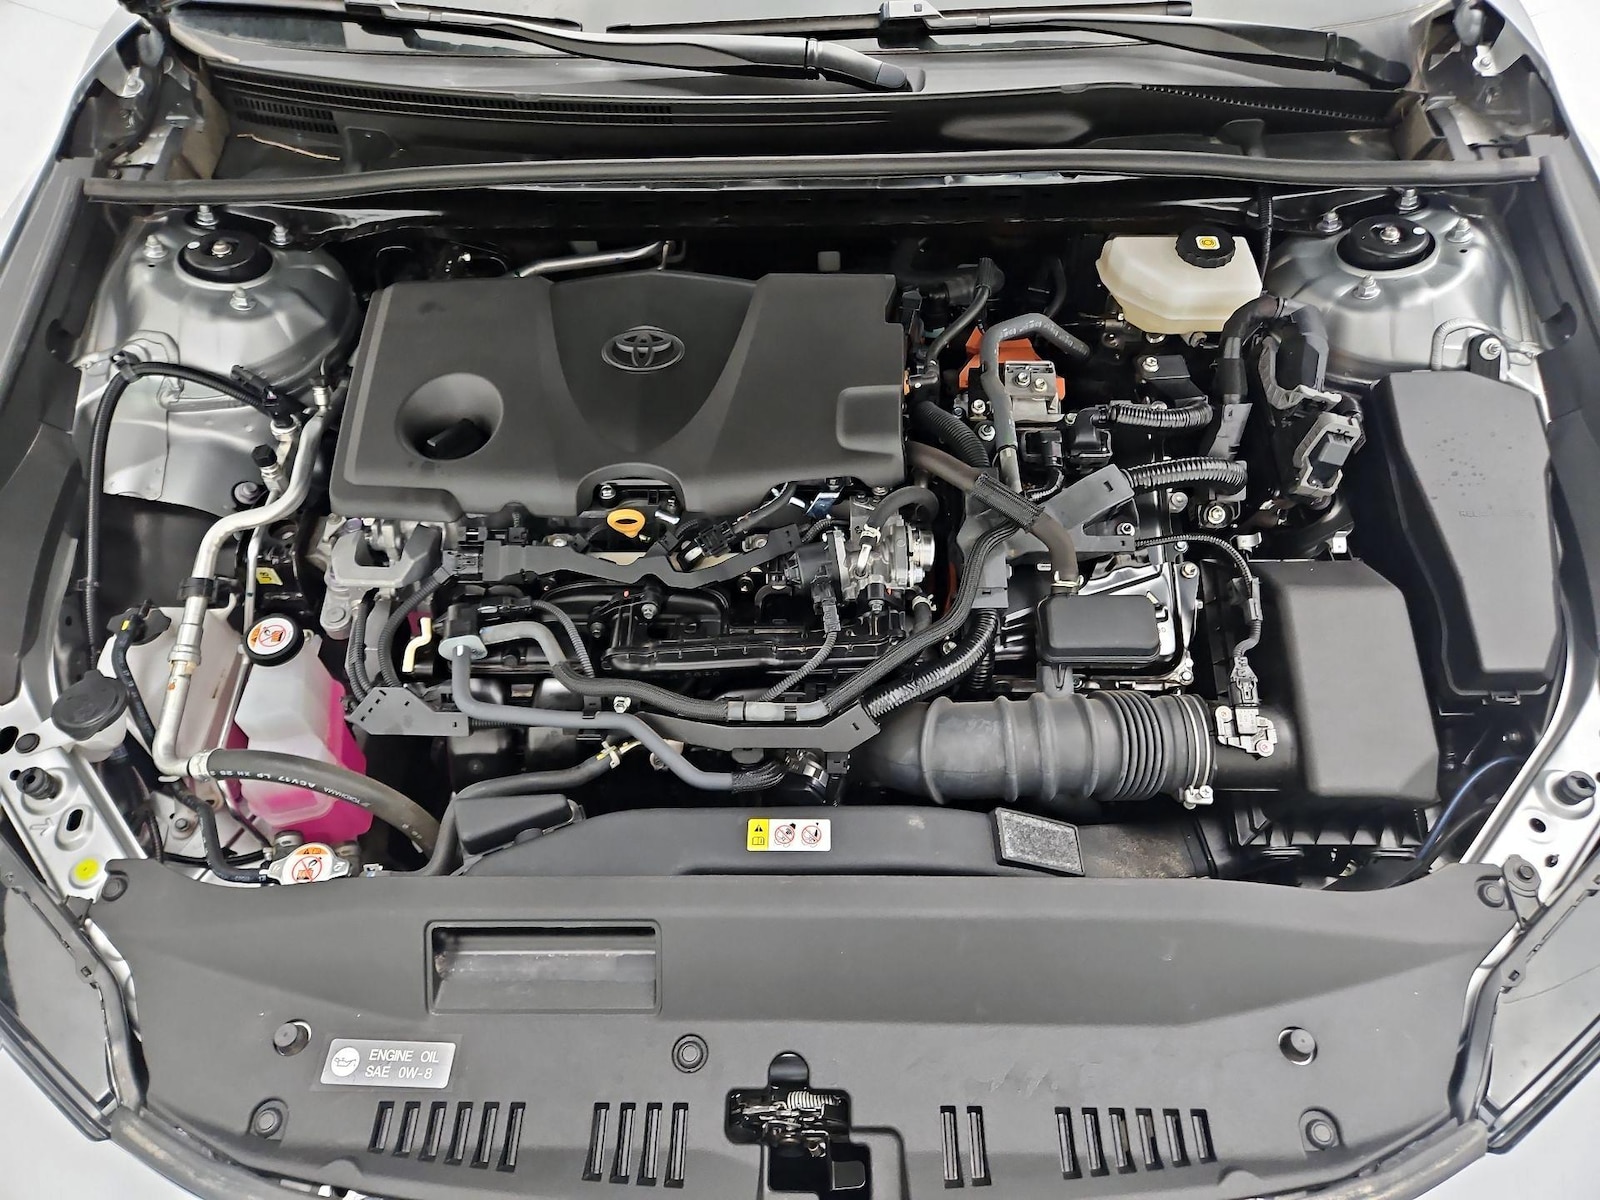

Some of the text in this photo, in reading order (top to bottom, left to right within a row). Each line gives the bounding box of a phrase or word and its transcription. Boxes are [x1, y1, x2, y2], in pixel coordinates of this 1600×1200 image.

[323, 786, 361, 805] YOKOHAMA
[369, 1048, 440, 1063] ENGINE OIL
[365, 1065, 433, 1080] SAE 0W-8
